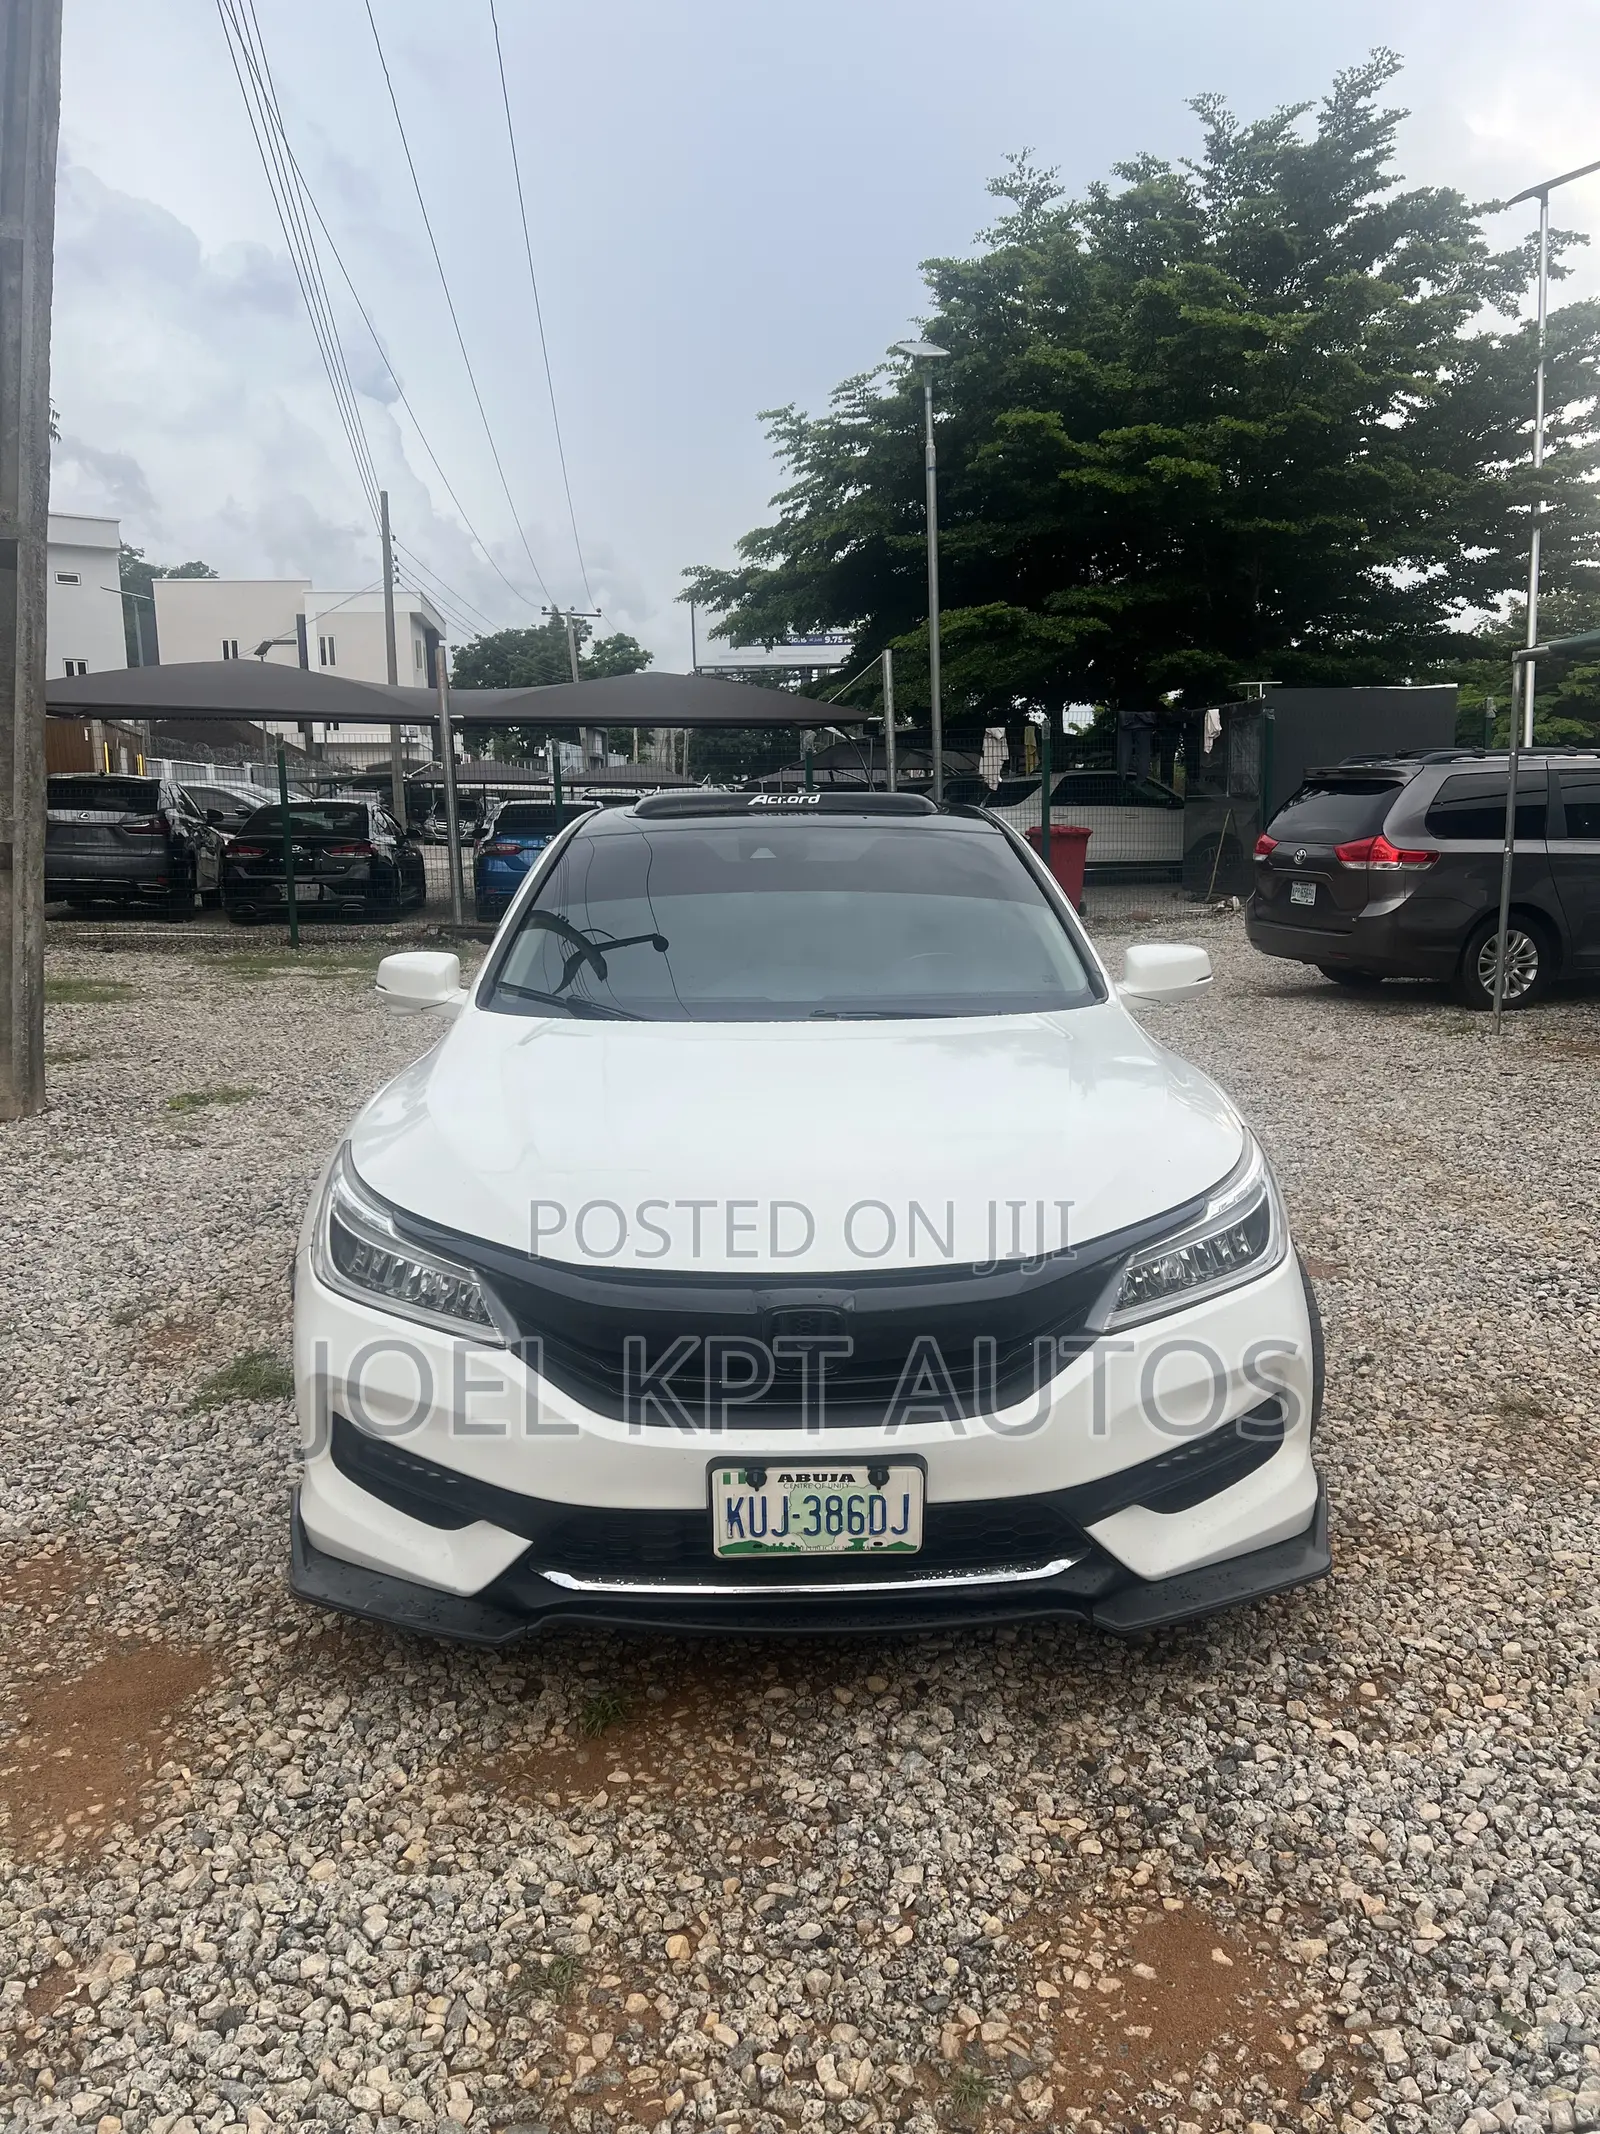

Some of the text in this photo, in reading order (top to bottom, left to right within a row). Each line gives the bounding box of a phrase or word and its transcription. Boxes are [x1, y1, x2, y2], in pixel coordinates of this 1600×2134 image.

[747, 794, 821, 806] Accord
[777, 1473, 856, 1483] ABUJA
[814, 1482, 827, 1490] OF
[726, 1493, 910, 1539] KUJ-386DJ
